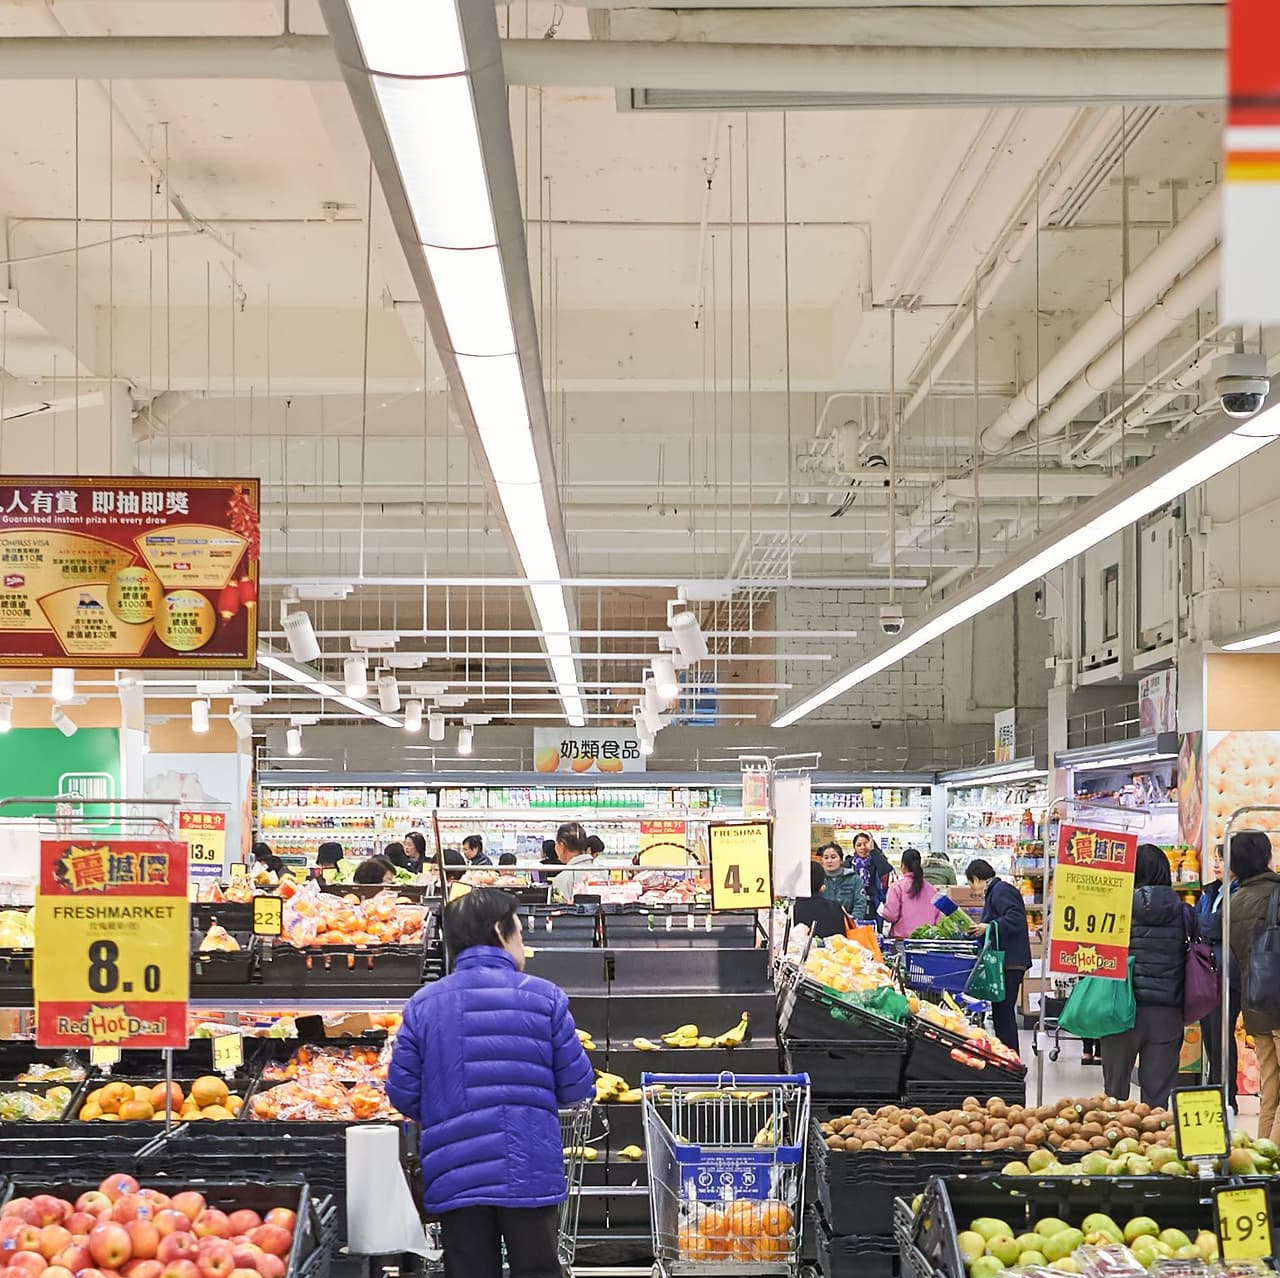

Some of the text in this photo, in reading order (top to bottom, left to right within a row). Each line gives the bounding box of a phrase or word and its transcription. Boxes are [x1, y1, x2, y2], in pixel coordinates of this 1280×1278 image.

[92, 490, 189, 515] 即抽即獎
[2, 515, 167, 526] Guaranteed instant prize in every draw
[560, 739, 640, 760] 奶類食品
[724, 865, 766, 894] 4.2
[1066, 872, 1124, 889] FRESHMARKET
[53, 905, 175, 919] FRESHMARKET
[88, 939, 161, 994] 8.0
[1060, 952, 1077, 965] Red
[1078, 953, 1096, 967] Hot
[58, 1015, 166, 1036] Red Hot Deal
